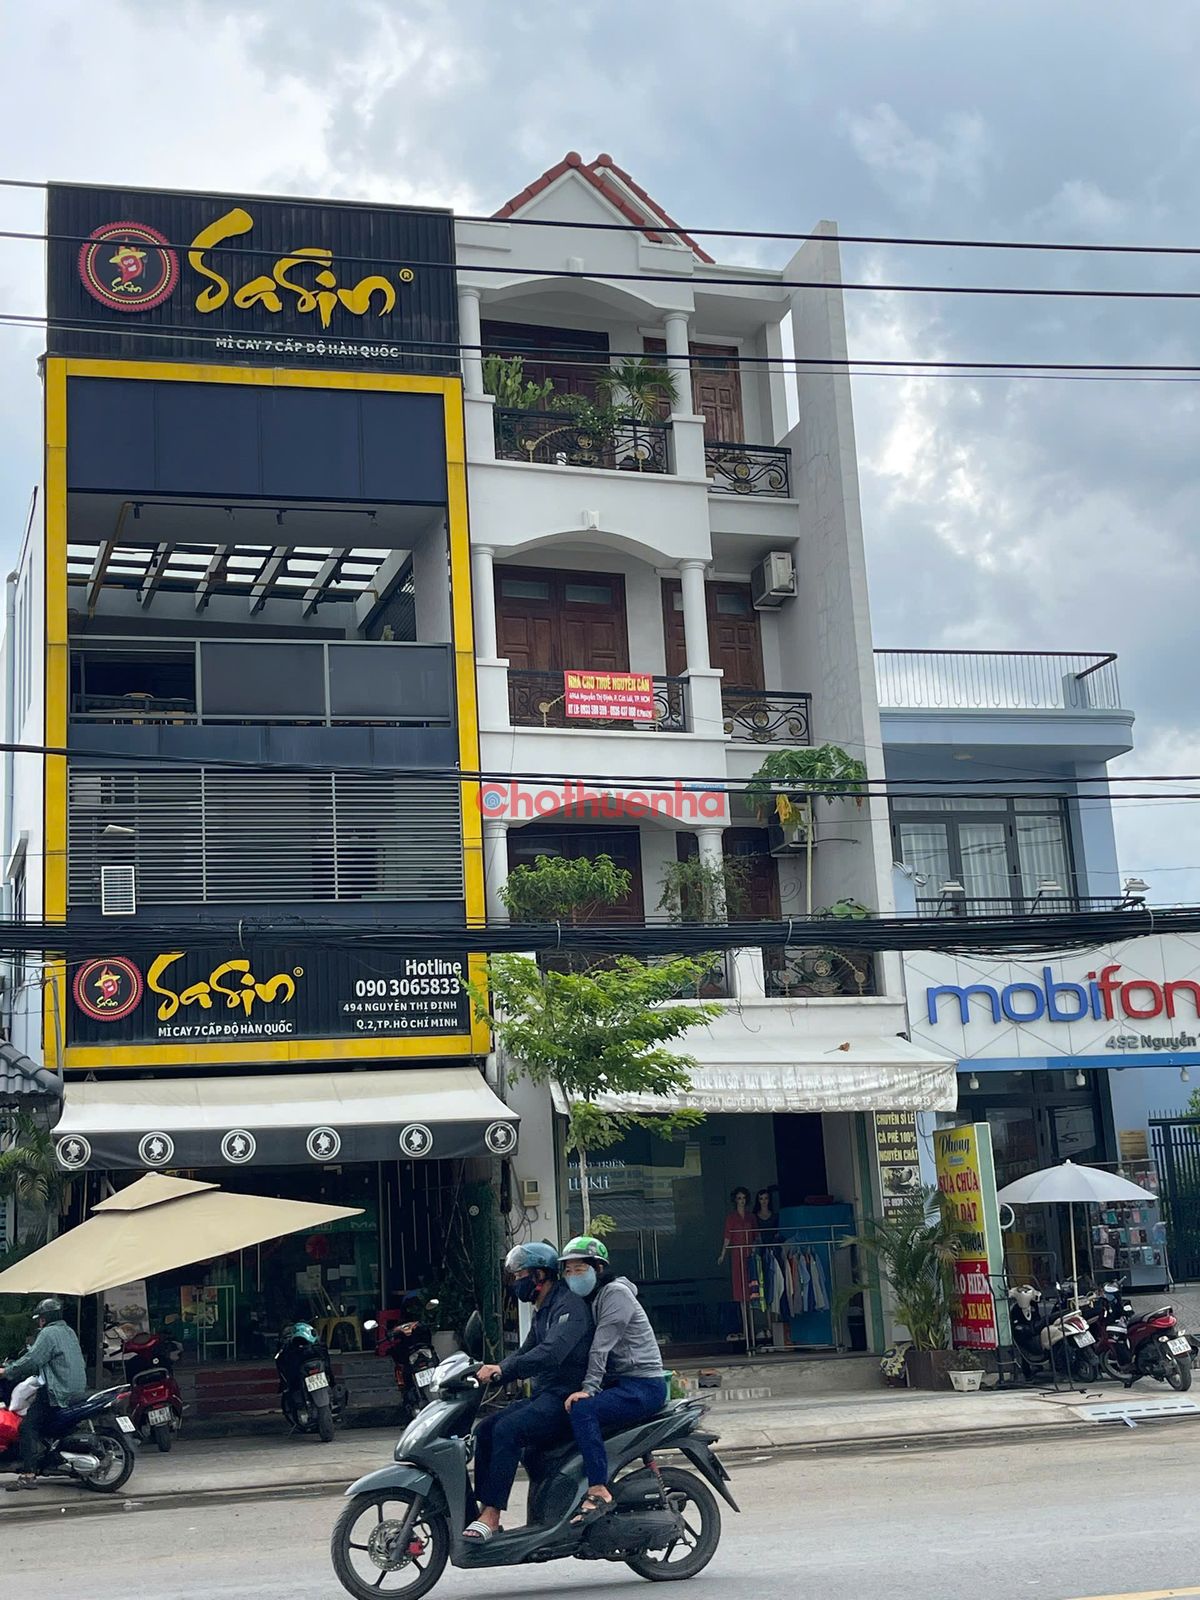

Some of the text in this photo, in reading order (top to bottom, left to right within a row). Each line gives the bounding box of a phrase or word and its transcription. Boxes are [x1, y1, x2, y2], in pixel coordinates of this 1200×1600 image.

[236, 339, 262, 350] CAY
[264, 342, 271, 350] 7
[328, 341, 357, 355] HÀN
[405, 959, 462, 976] Hotline
[355, 978, 460, 997] 090 3065833
[343, 1003, 363, 1012] 494
[409, 1002, 428, 1013] THỊ
[430, 1001, 457, 1013] ĐỊNH
[158, 1023, 171, 1037] MÌ
[172, 1026, 192, 1037] CAY
[194, 1026, 200, 1036] 7
[223, 1022, 239, 1037] ĐỘ
[240, 1021, 263, 1034] HÀN
[409, 1016, 429, 1028] CHÍ
[430, 1018, 458, 1028] MINH
[1105, 1035, 1139, 1049] 492
